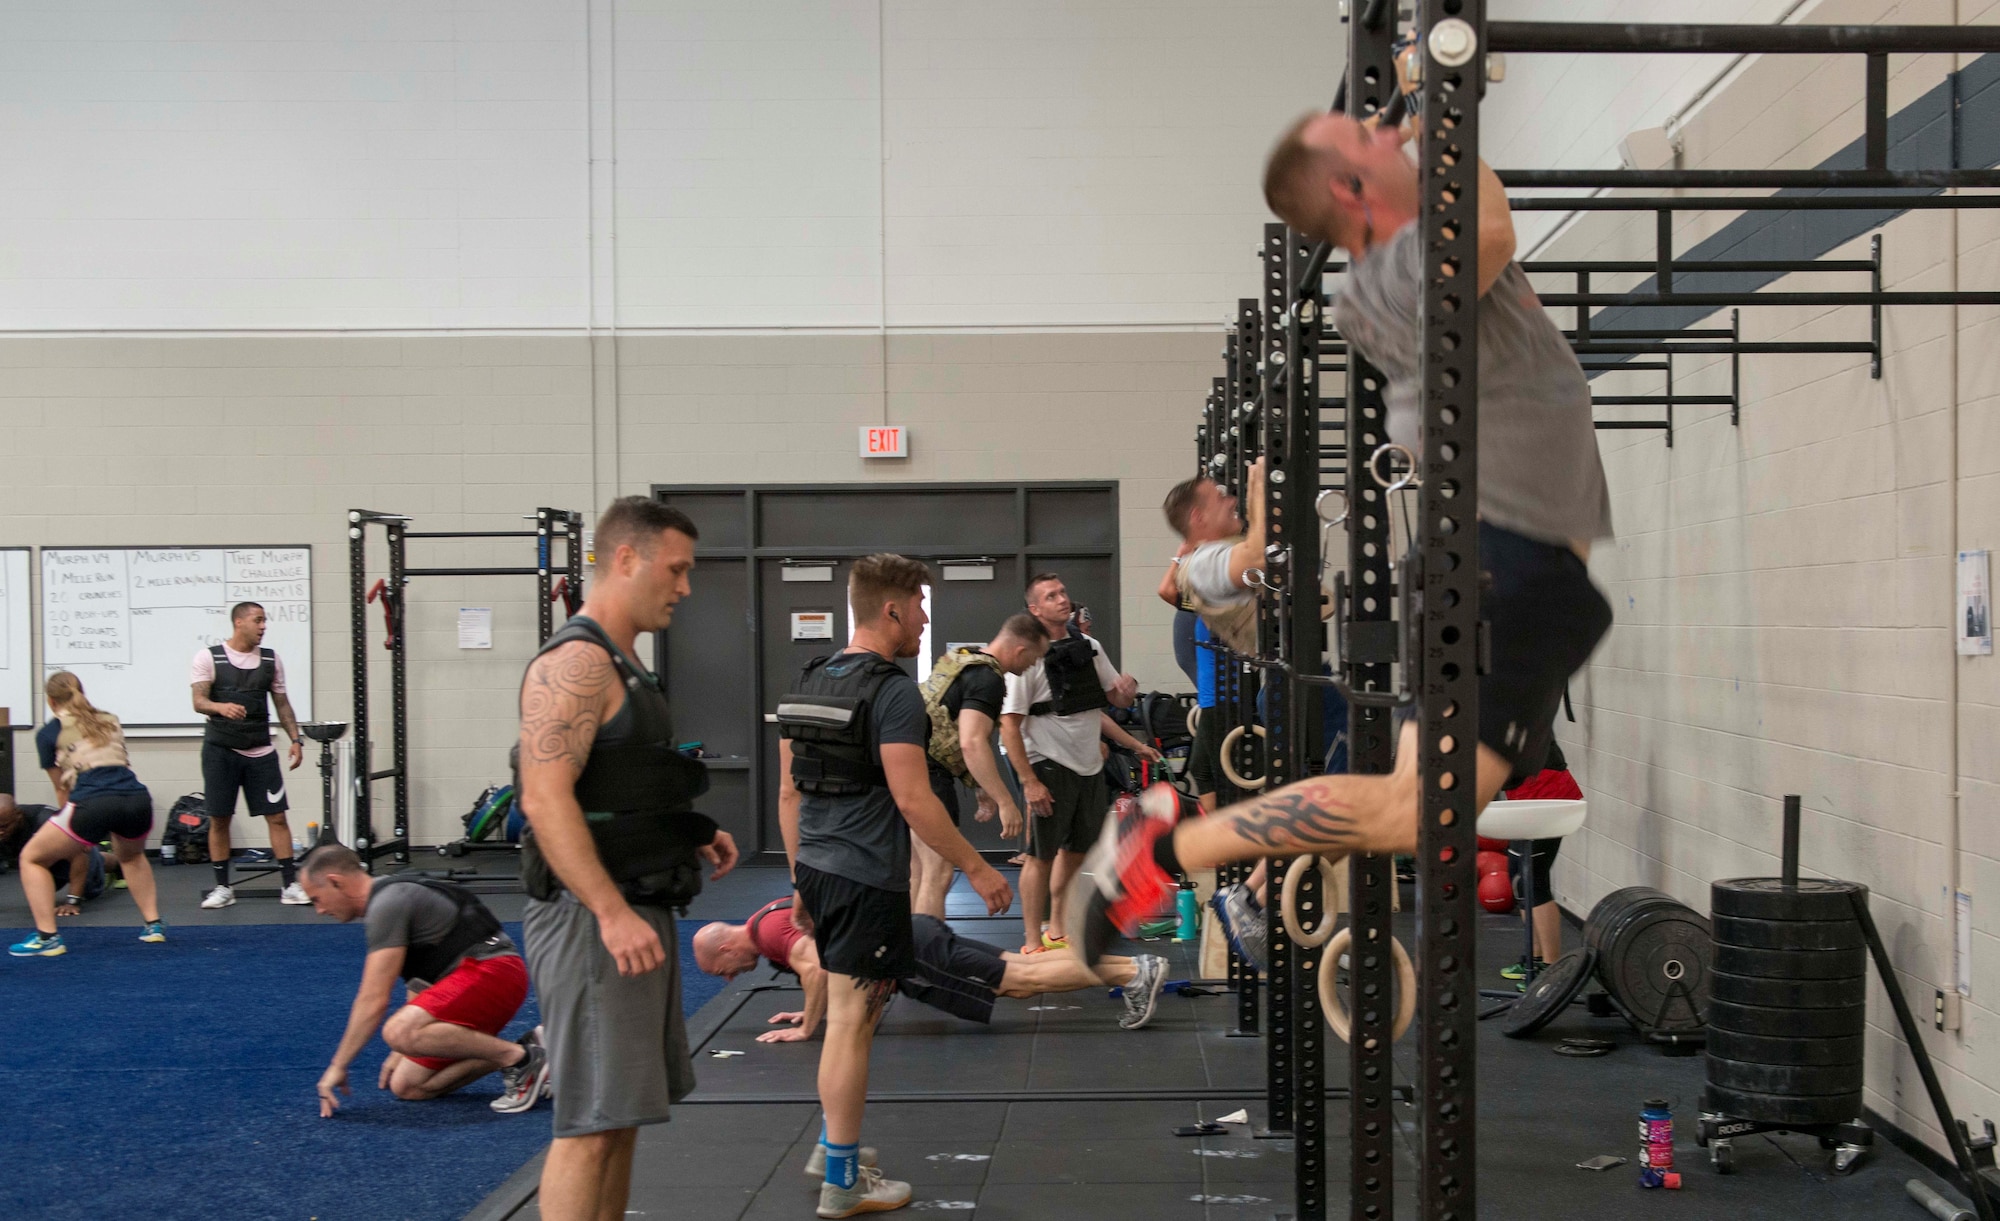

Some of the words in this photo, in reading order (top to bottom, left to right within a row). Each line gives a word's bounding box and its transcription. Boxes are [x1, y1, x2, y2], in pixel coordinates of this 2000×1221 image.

[868, 429, 899, 452] EXIT
[44, 551, 89, 566] MURPH
[133, 551, 183, 565] MURPH
[226, 551, 256, 565] THE
[261, 551, 304, 564] MURPH
[61, 572, 93, 584] MILE
[95, 572, 115, 583] RUN
[240, 567, 304, 579] CHALLENGE
[134, 575, 145, 588] 2
[148, 577, 172, 587] MILE
[233, 586, 252, 597] 24
[256, 585, 286, 597] MAY
[288, 584, 304, 596] 18
[50, 625, 72, 637] 20
[79, 626, 118, 637] SQUATS
[67, 640, 96, 650] MILE
[98, 640, 123, 649] RUN
[1718, 1121, 1755, 1136] ROGUE
